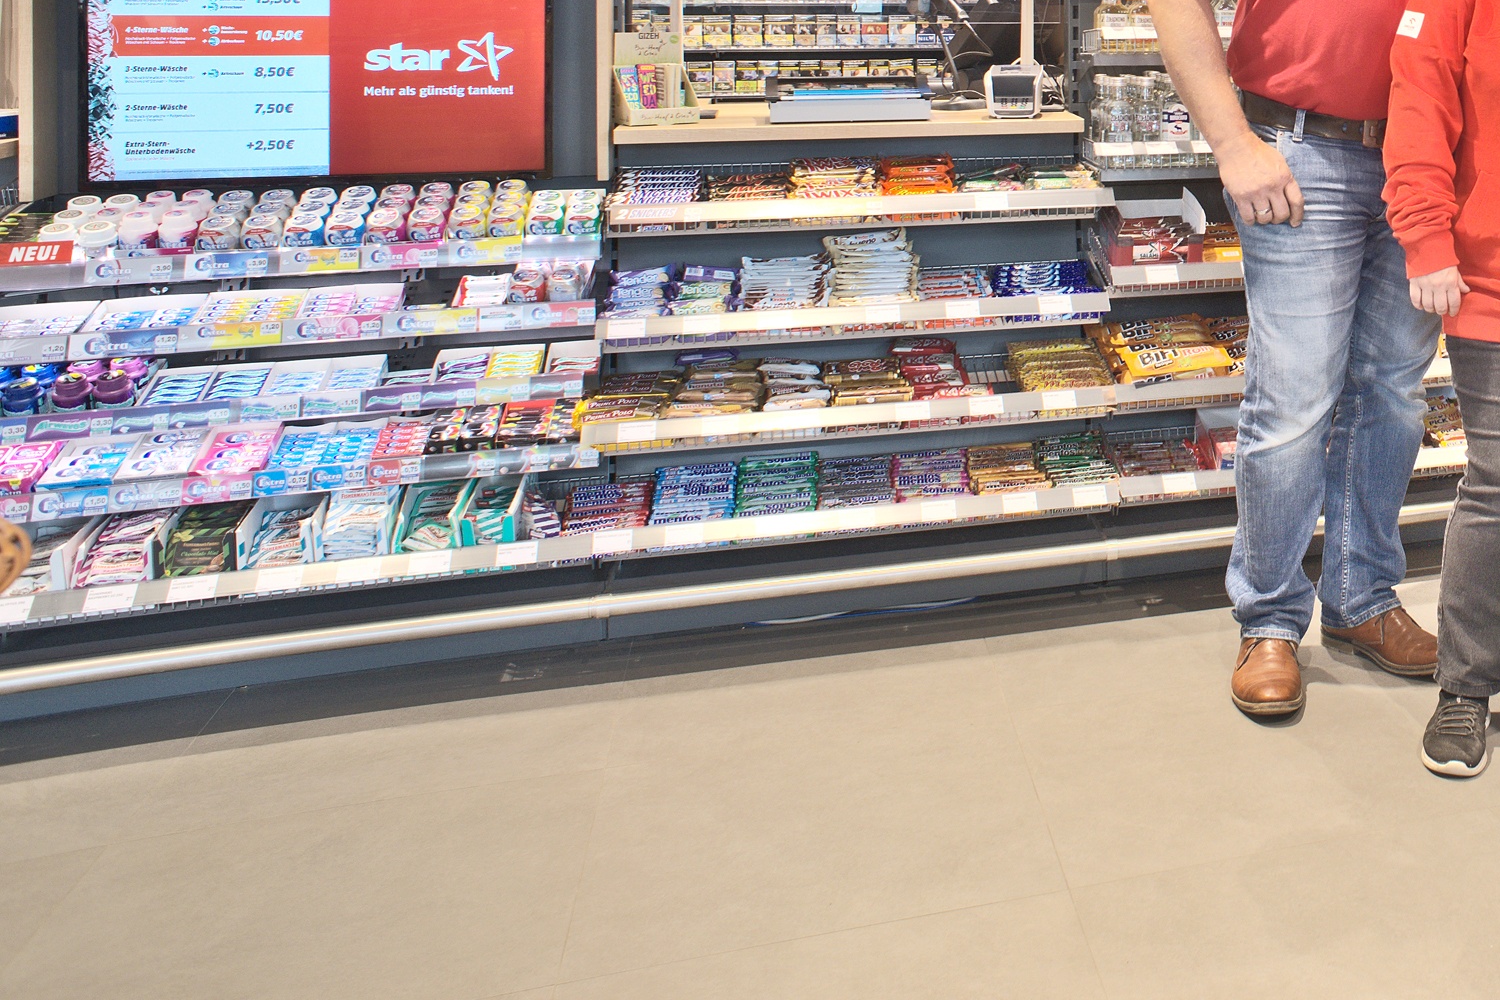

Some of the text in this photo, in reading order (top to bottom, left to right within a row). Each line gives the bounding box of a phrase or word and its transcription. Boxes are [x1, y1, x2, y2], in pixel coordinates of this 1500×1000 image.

[125, 26, 304, 42] 4-Sterne-Wäsche 10,50€
[364, 42, 450, 71] star
[125, 65, 295, 77] 3-Sterne-Wäsche 8,50€
[364, 85, 514, 98] Mehr als günstig tanken!
[255, 103, 294, 115] 7,50€
[246, 139, 295, 151] +2,50€
[125, 147, 196, 155] Unterbodenwäsche
[801, 189, 853, 198] TWIX
[615, 208, 676, 219] 2 SNICKERS
[8, 245, 61, 263] NEU!
[198, 259, 229, 270] Extra
[621, 273, 658, 286] Tender
[617, 287, 653, 299] Tender
[681, 284, 719, 295] Tender
[674, 305, 711, 315] Tender
[688, 382, 724, 390] hanuta
[589, 398, 639, 409] PRINCE POLO
[584, 408, 634, 421] PRINCE POLO
[900, 451, 942, 459] mentos
[315, 470, 364, 483] Extra 0,75
[372, 467, 399, 478] Extra
[258, 476, 307, 487] Extra 0,75
[742, 480, 787, 488] mentos
[191, 483, 226, 494] Extra
[11, 505, 28, 513] 4,30
[43, 497, 107, 511] Extra 1,50
[738, 508, 785, 517] mentos
[654, 514, 702, 525] mentos
